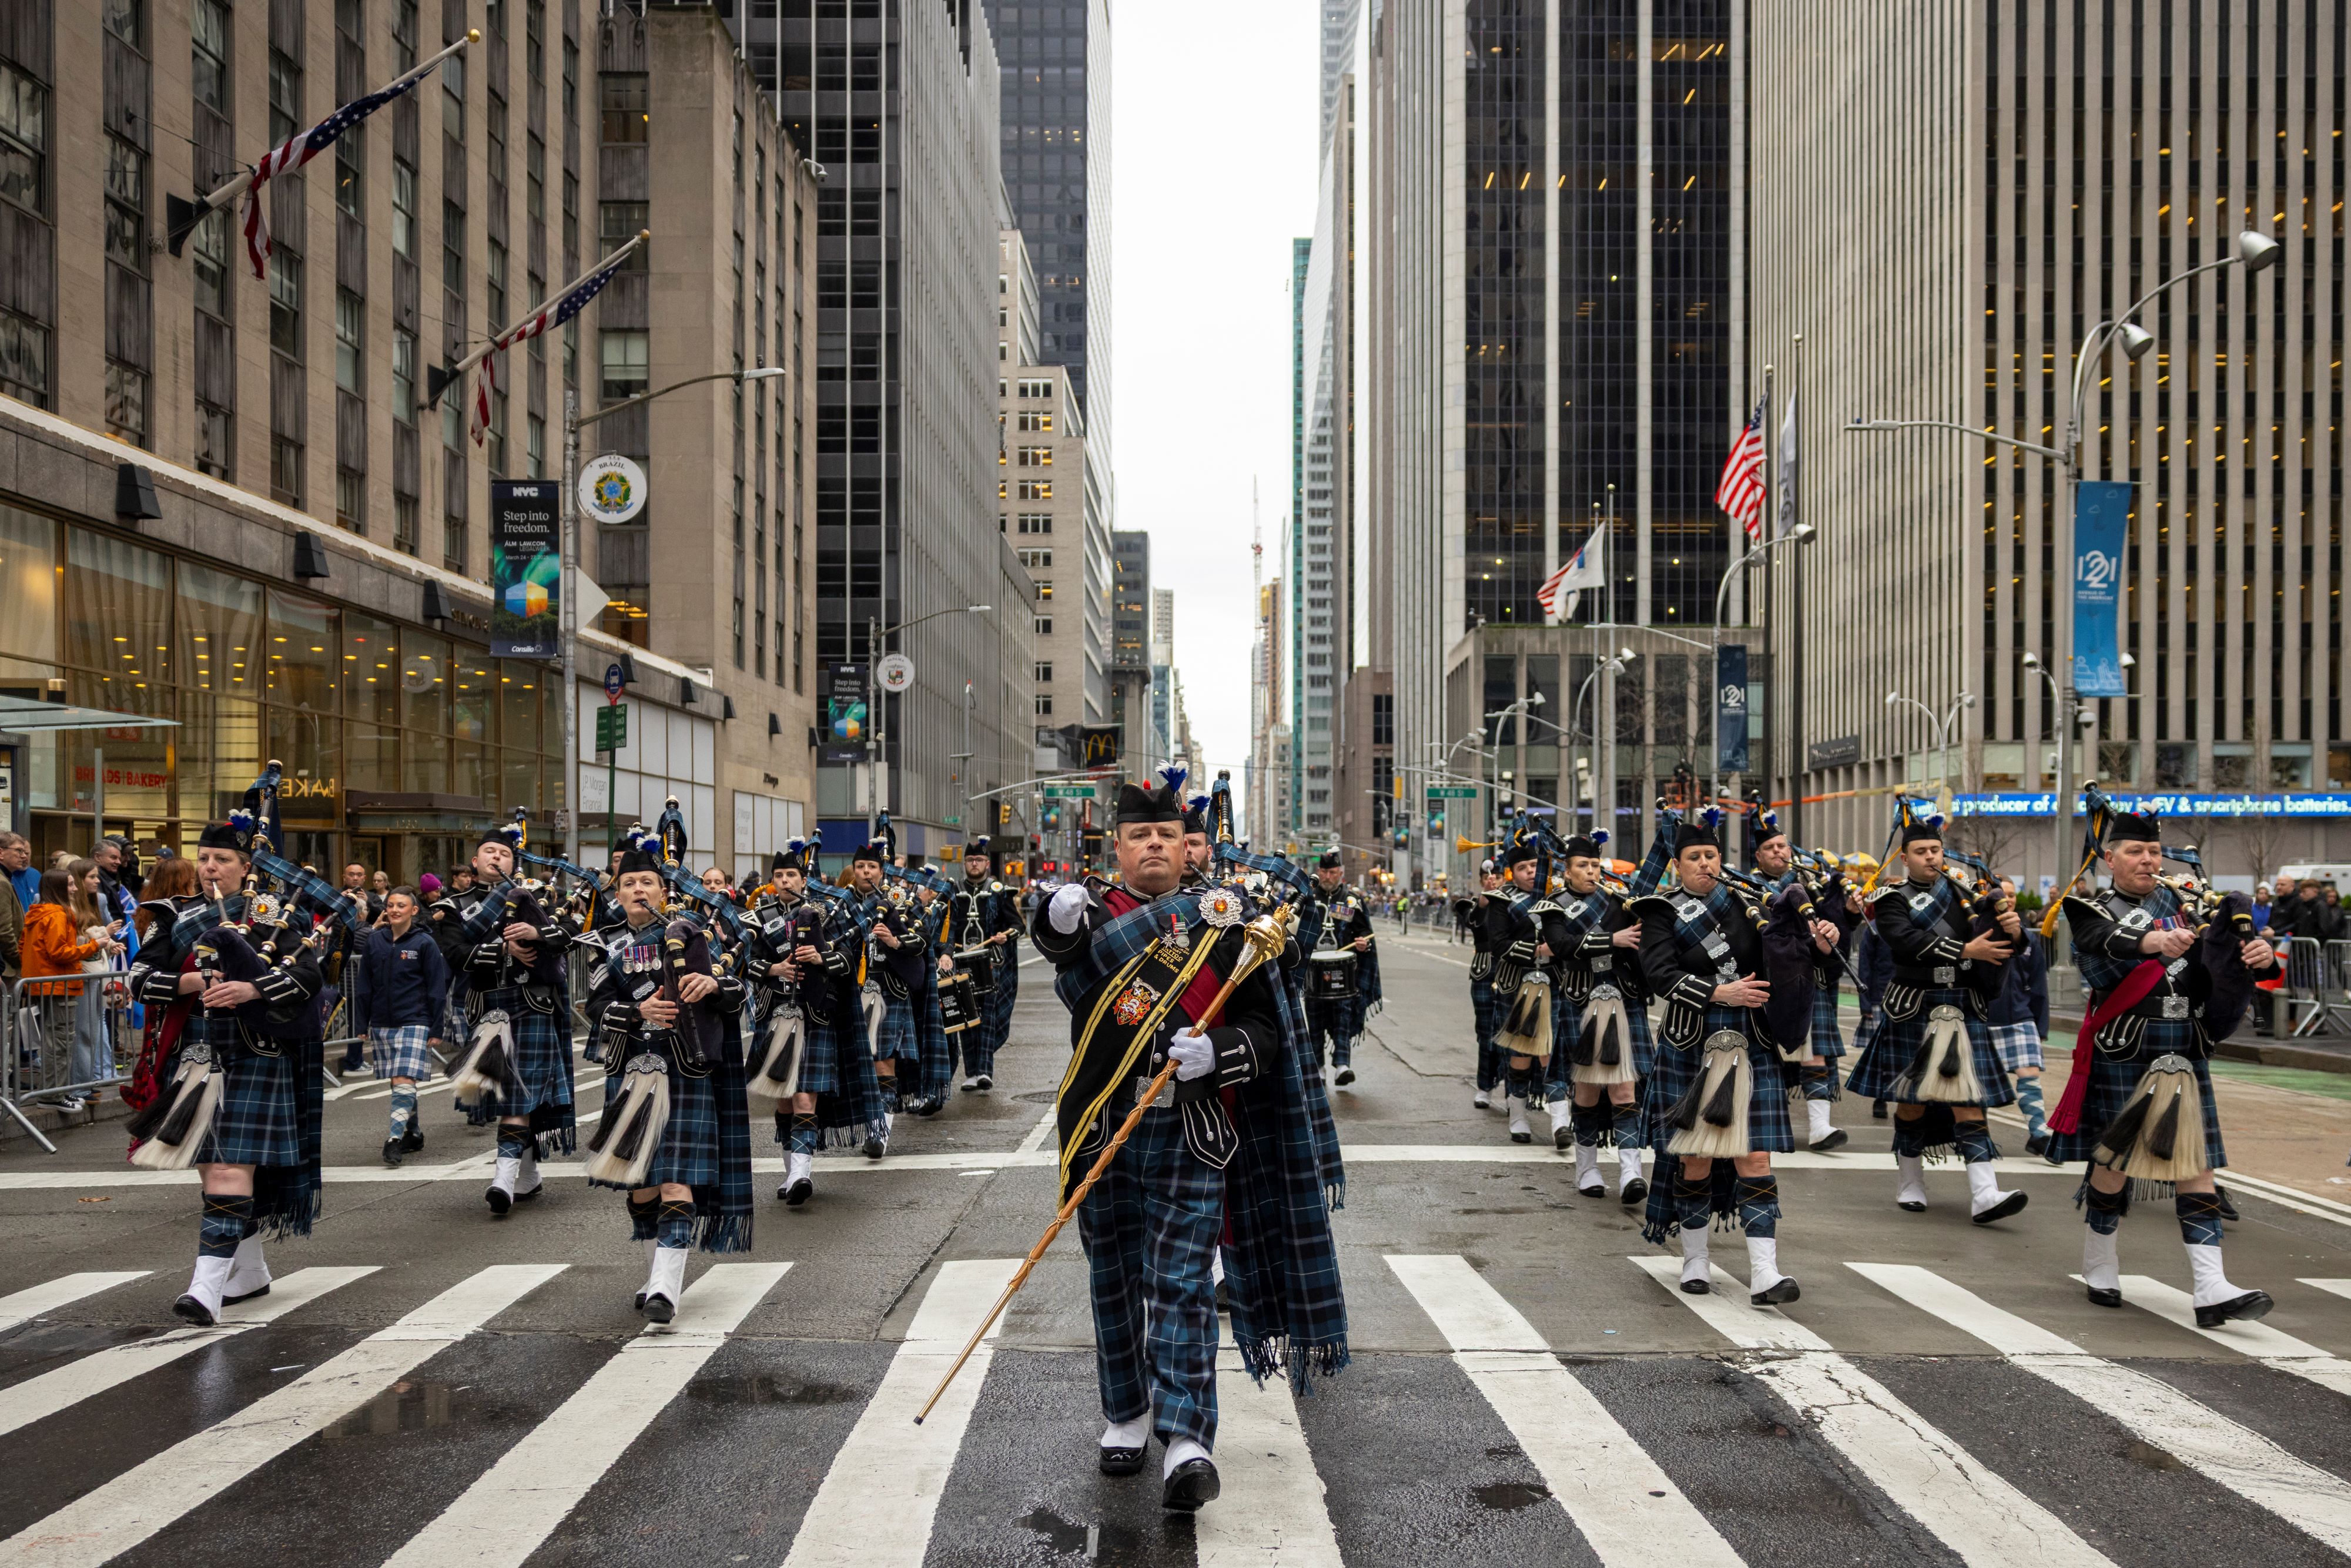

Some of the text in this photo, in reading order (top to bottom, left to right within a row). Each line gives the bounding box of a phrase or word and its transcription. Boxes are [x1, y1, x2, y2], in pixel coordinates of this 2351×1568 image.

[598, 461, 625, 470] BRAZIL
[513, 487, 538, 497] NYC
[504, 510, 549, 522] Step into
[504, 522, 550, 533] freedom.
[615, 706, 625, 715] QM2
[615, 716, 624, 725] QM3
[126, 770, 167, 789] BAKERY
[590, 776, 607, 795] Morgan
[582, 796, 602, 812] Financial
[1962, 795, 2030, 816] producer
[2033, 795, 2050, 812] of
[2177, 796, 2192, 813] &
[2194, 795, 2282, 817] smartphone
[2284, 795, 2351, 813] batteries.
[1158, 950, 1174, 963] PIPES
[1158, 957, 1179, 973] DRUMS
